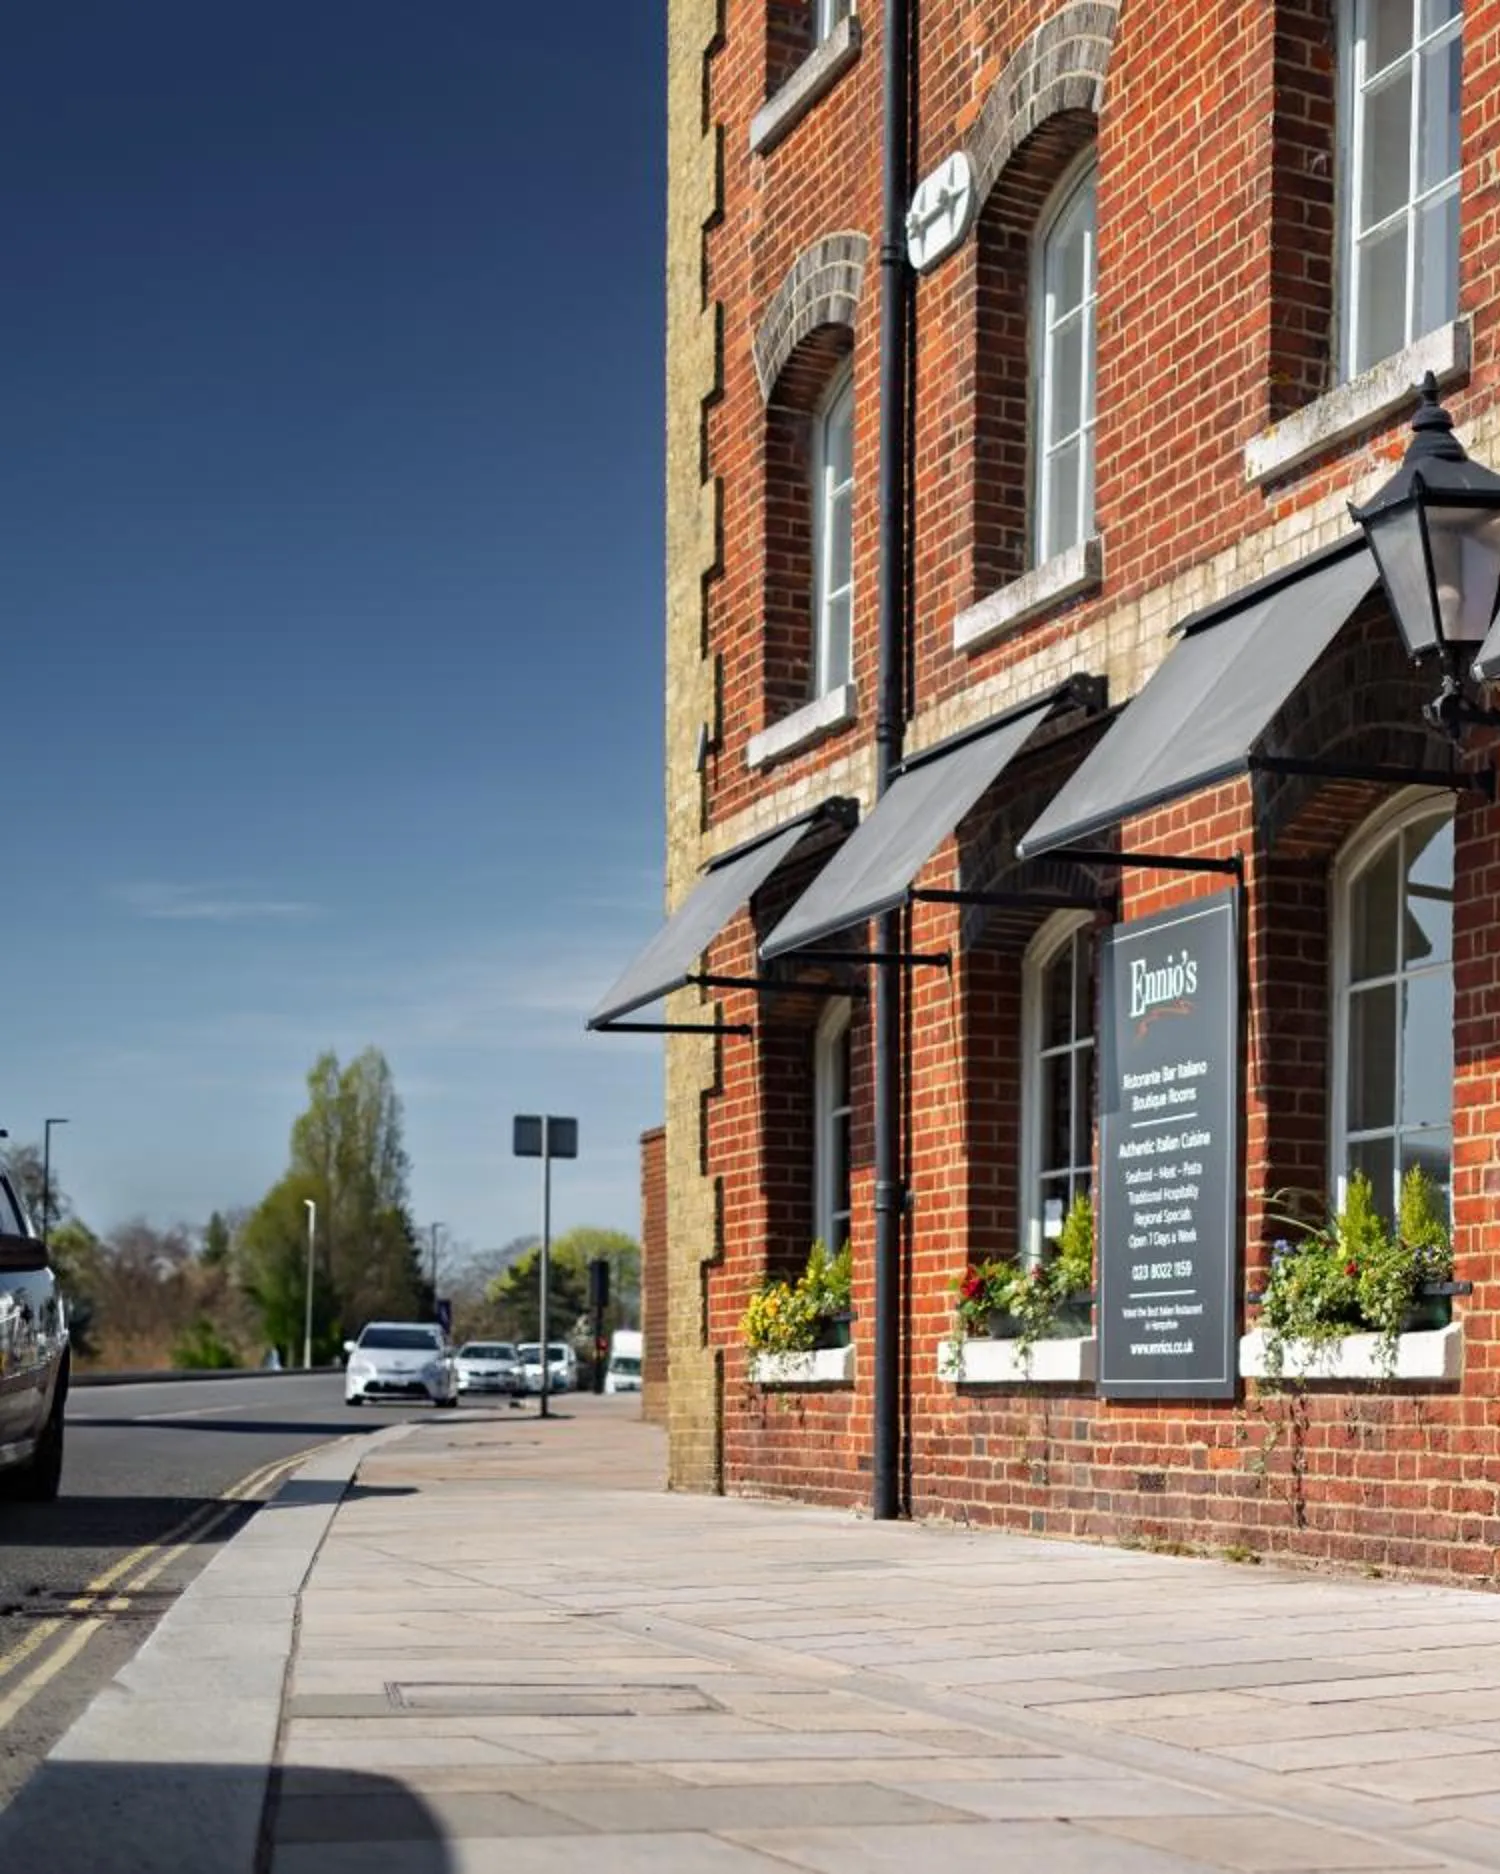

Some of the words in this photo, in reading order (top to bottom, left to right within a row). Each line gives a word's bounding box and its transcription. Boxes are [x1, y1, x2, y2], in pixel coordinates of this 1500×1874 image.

[1129, 949, 1198, 1018] Ennio's
[1162, 1066, 1177, 1082] Bar
[1181, 1129, 1211, 1149] Cuisine
[1128, 1234, 1148, 1249] Open
[1153, 1231, 1171, 1247] Days
[1131, 1263, 1149, 1281] 023
